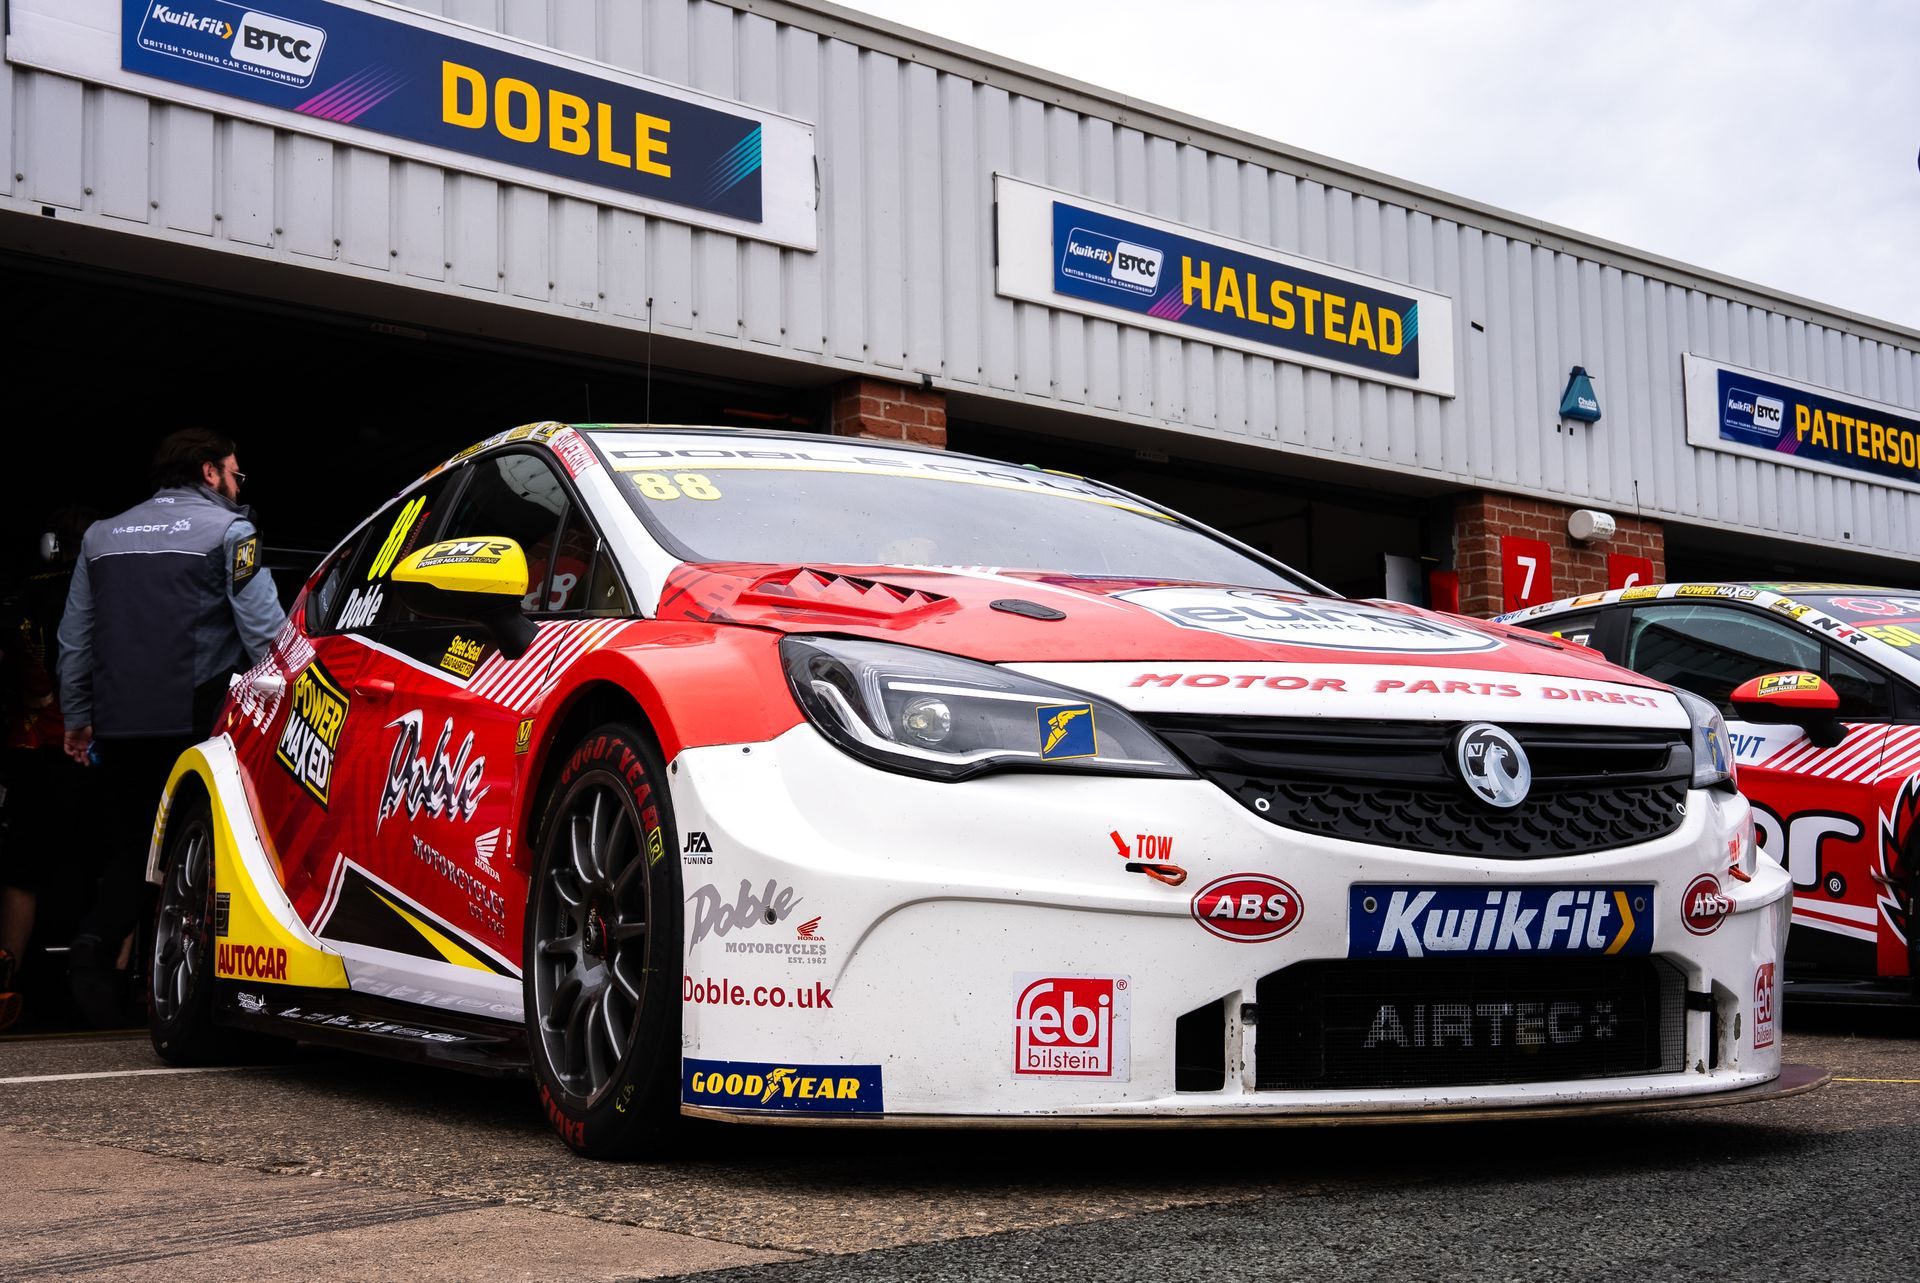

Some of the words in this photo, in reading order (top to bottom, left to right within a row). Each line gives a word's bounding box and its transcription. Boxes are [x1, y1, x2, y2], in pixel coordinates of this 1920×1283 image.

[143, 38, 178, 53] BRITISH
[181, 48, 220, 64] TOURING
[222, 58, 240, 69] CAR
[242, 64, 305, 84] CHAMPIONSHIP
[243, 25, 312, 63] BTCC
[442, 60, 672, 178] DOBLE
[1065, 267, 1084, 276] BRITISH
[1085, 272, 1106, 283] TOURING
[1118, 252, 1156, 277] BTCC
[1182, 255, 1403, 356] HALSTEAD
[1757, 404, 1780, 422] BTCC
[632, 473, 722, 501] 88
[112, 524, 169, 534] M-SPORT
[367, 495, 427, 581] 88
[418, 559, 442, 568] POWER
[443, 557, 469, 565] MAXED
[1517, 555, 1537, 600] 7
[335, 583, 384, 630] Doble
[1681, 584, 1717, 595] POWER
[1717, 585, 1756, 598] MAXED
[1127, 673, 1348, 692] MOTOR
[1373, 679, 1522, 697] PARTS
[1541, 687, 1661, 709] DIRECT
[294, 672, 343, 748] POWER
[281, 710, 330, 790] MAXED
[683, 832, 713, 852] JFA
[1136, 834, 1173, 860] TOW
[412, 834, 506, 920] MOTORCYCLES
[474, 856, 501, 883] HONDA
[685, 879, 804, 957] Doble
[1210, 893, 1288, 921] ABS
[1690, 892, 1729, 918] ABS
[218, 943, 288, 981] AUTOCAR
[725, 942, 827, 956] MOTORCYCLES
[787, 957, 805, 965] EST.
[807, 957, 827, 965] 1967
[683, 975, 834, 1009] Doble.co.uk
[1016, 982, 1110, 1046] febi
[1363, 1001, 1584, 1048] AIRTEC
[1028, 1047, 1099, 1069] bilstein
